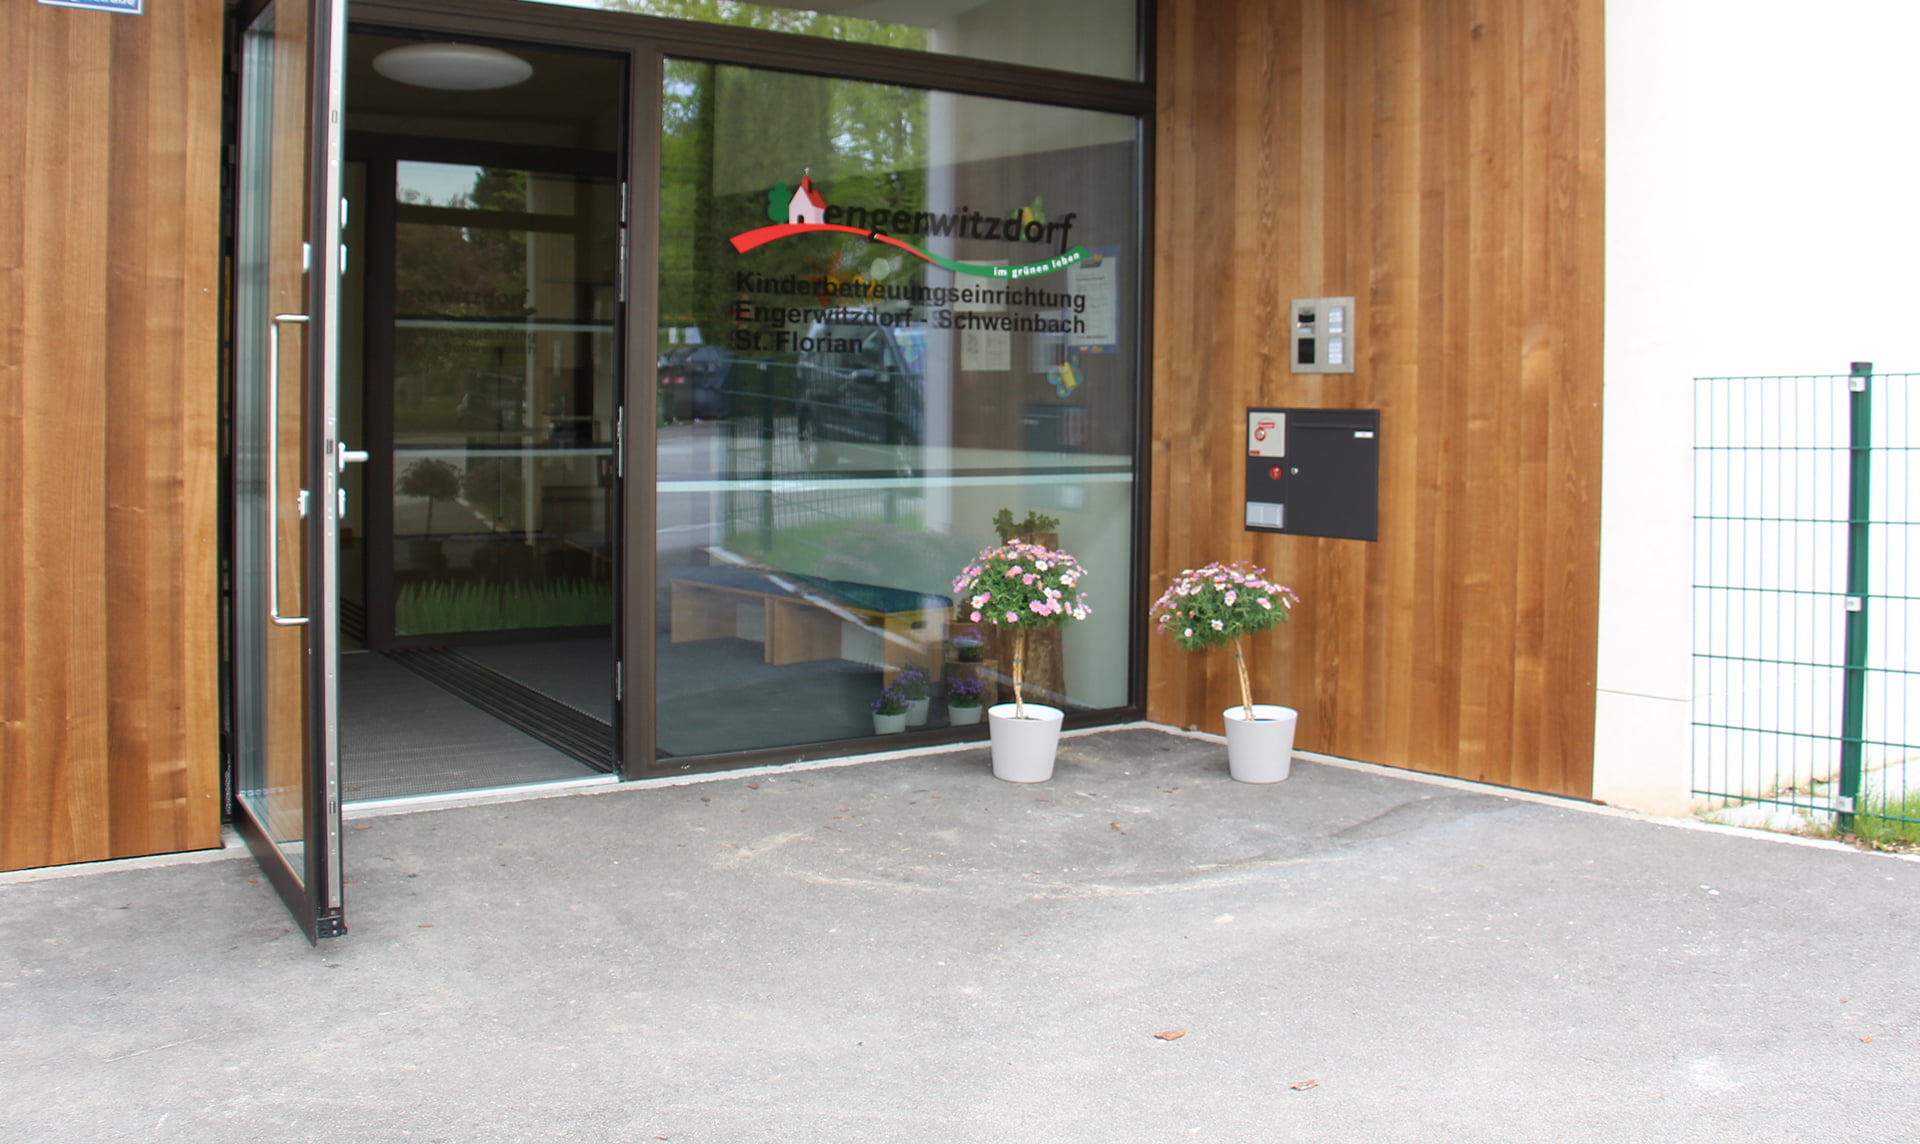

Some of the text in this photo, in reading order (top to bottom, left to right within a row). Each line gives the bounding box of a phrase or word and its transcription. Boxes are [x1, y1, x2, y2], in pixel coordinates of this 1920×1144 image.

[822, 203, 1077, 254] engerwitzdorf
[993, 266, 1008, 277] im
[1011, 264, 1049, 279] grünen
[1051, 251, 1081, 269] leben
[735, 271, 1086, 313] Kinderbetreuungseinrichtung
[735, 299, 913, 328] Engerwitzdorf
[938, 309, 1086, 334] Schweinbach
[735, 328, 863, 354] St. Florian
